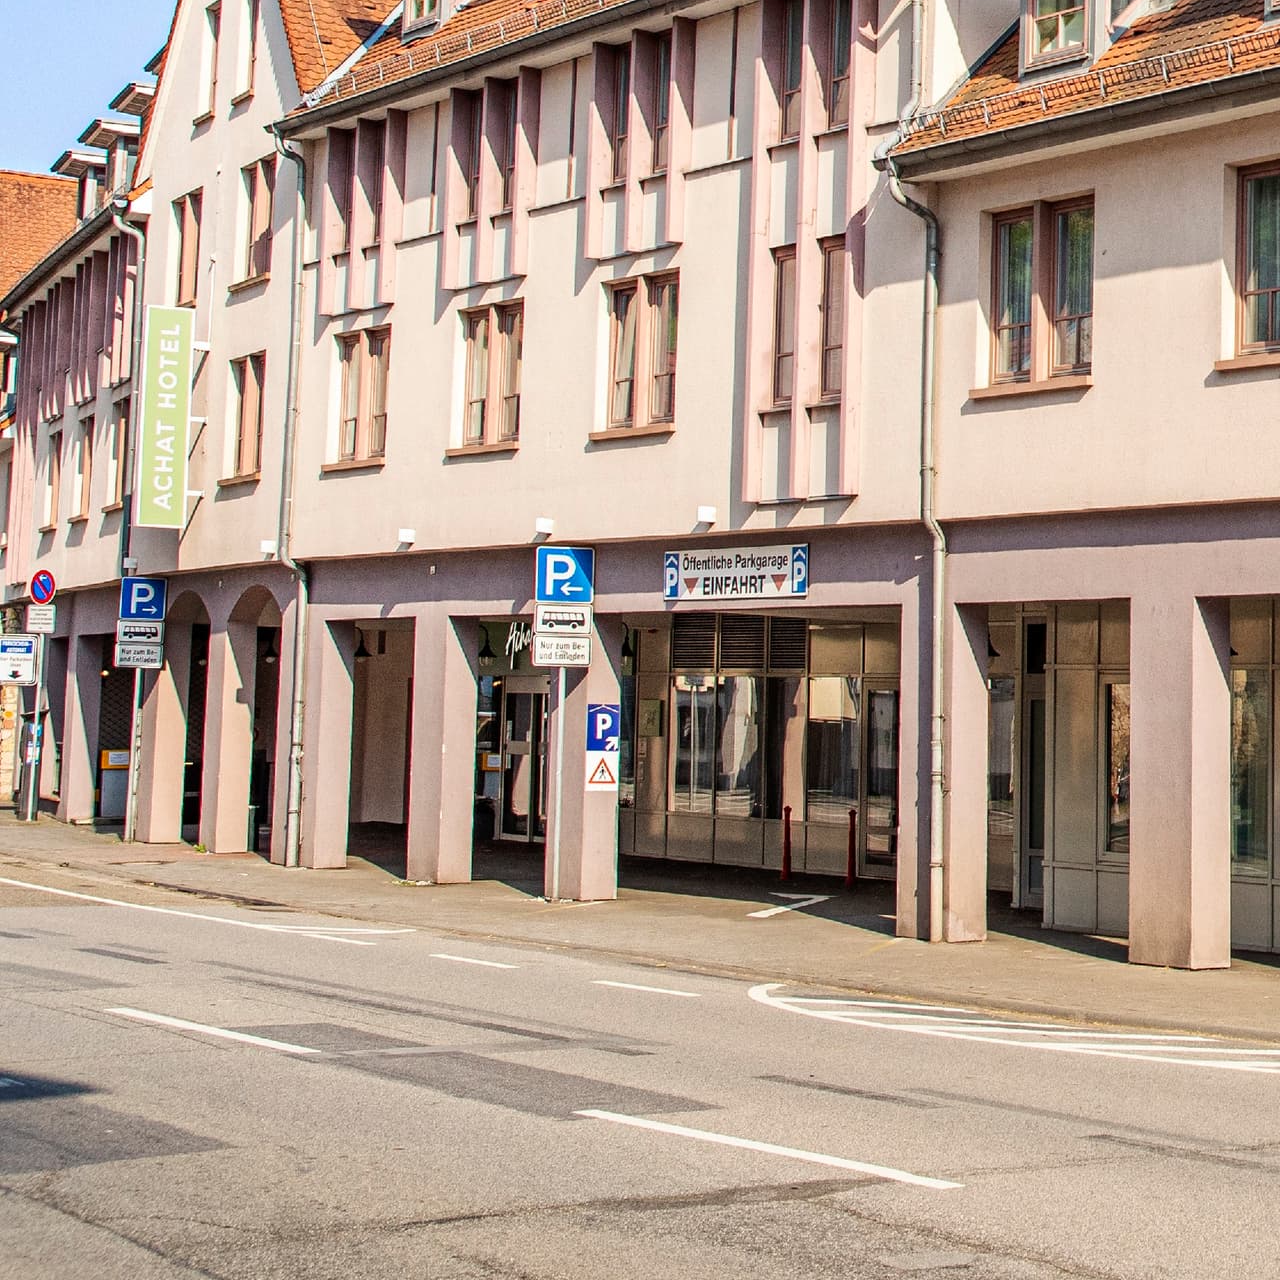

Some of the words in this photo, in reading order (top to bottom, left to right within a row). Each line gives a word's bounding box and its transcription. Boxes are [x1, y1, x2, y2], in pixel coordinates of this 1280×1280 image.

[158, 324, 180, 409] HOTEL
[153, 421, 175, 510] ACHAT
[545, 554, 577, 595] P
[682, 553, 732, 571] Öffentliche
[735, 553, 788, 571] Parkgarage
[793, 561, 806, 592] P
[665, 567, 678, 596] P
[703, 574, 766, 595] EINFAHRT
[130, 583, 155, 614] P
[539, 651, 552, 660] und
[540, 640, 553, 649] Nur
[572, 641, 585, 650] Be-
[595, 713, 613, 740] P
